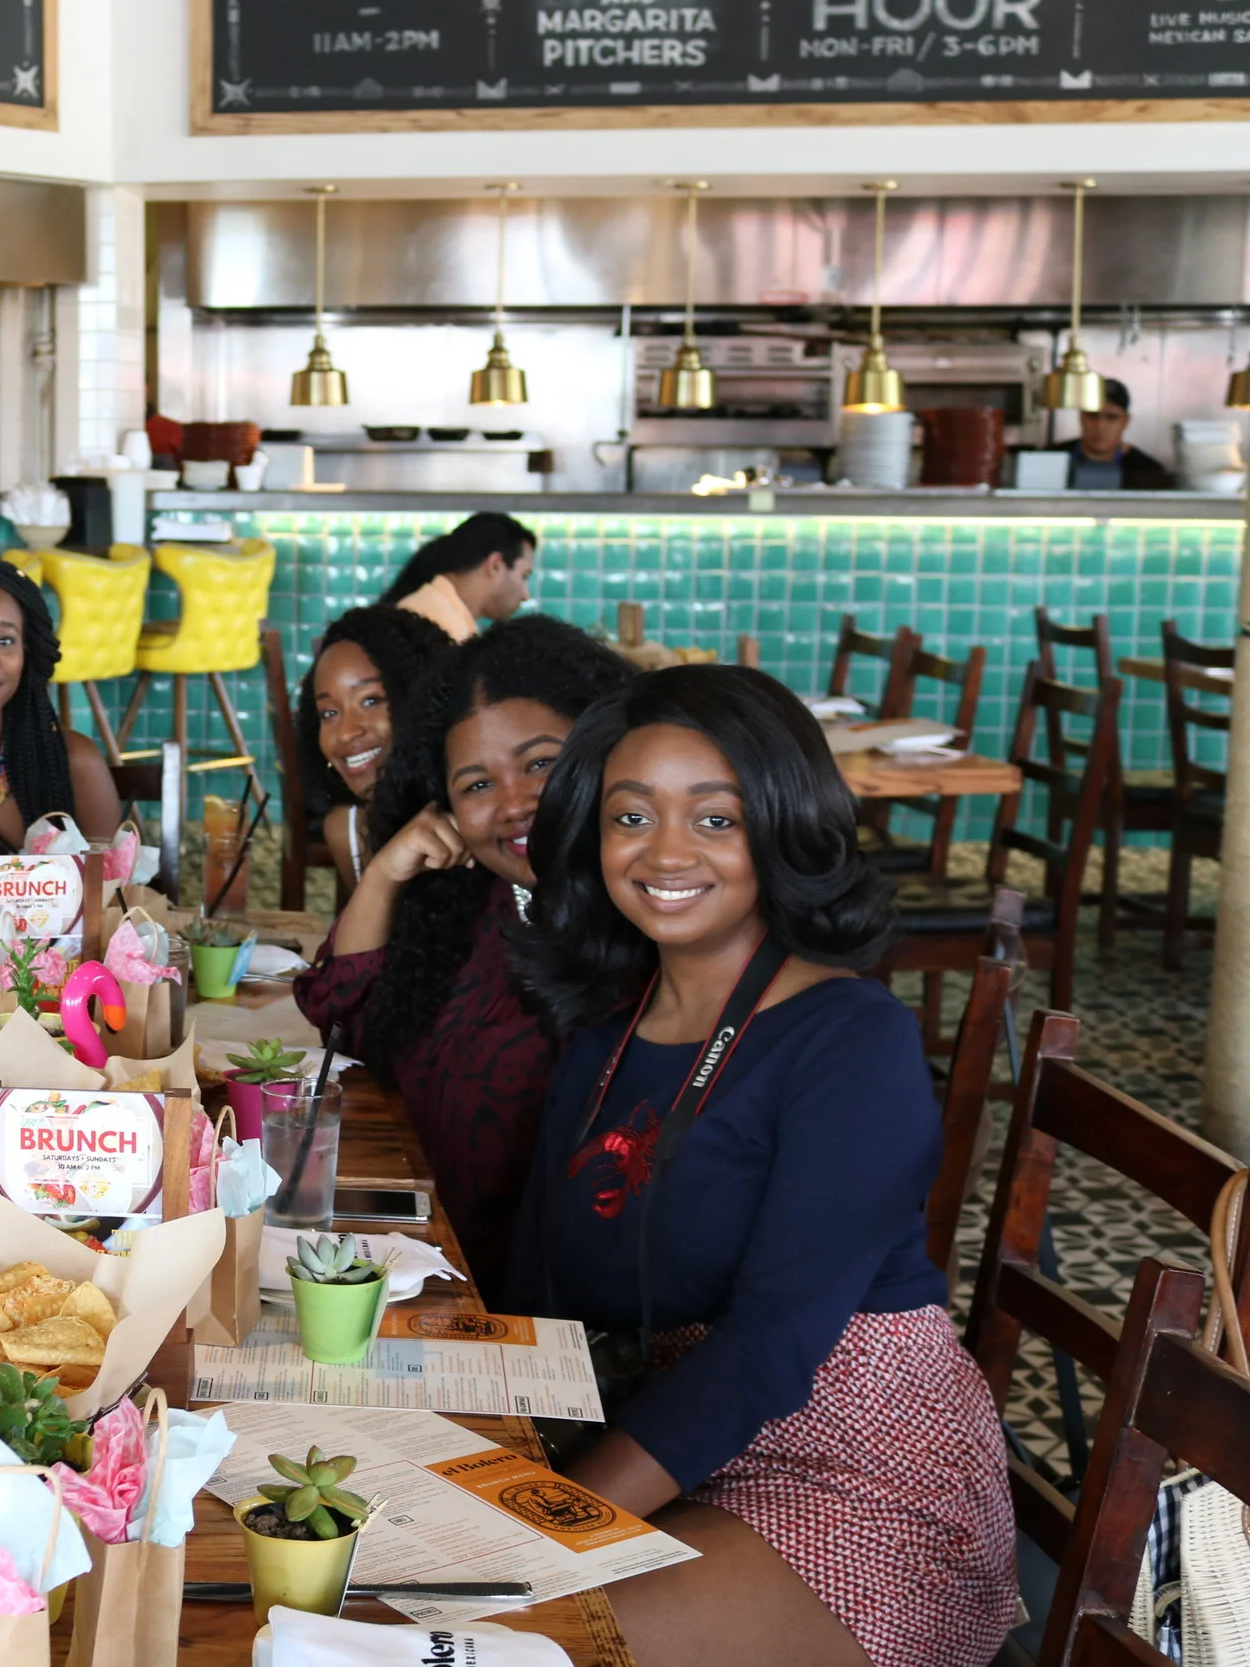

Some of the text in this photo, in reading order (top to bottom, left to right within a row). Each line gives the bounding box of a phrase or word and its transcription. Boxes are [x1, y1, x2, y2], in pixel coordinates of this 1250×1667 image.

[536, 7, 717, 35] MARGARITA
[542, 38, 709, 67] PITCHERS
[692, 1026, 735, 1087] Canon
[20, 1128, 137, 1153] BRUNCH
[42, 1154, 80, 1162] SATURDAYS
[442, 1454, 517, 1477] el Bolero
